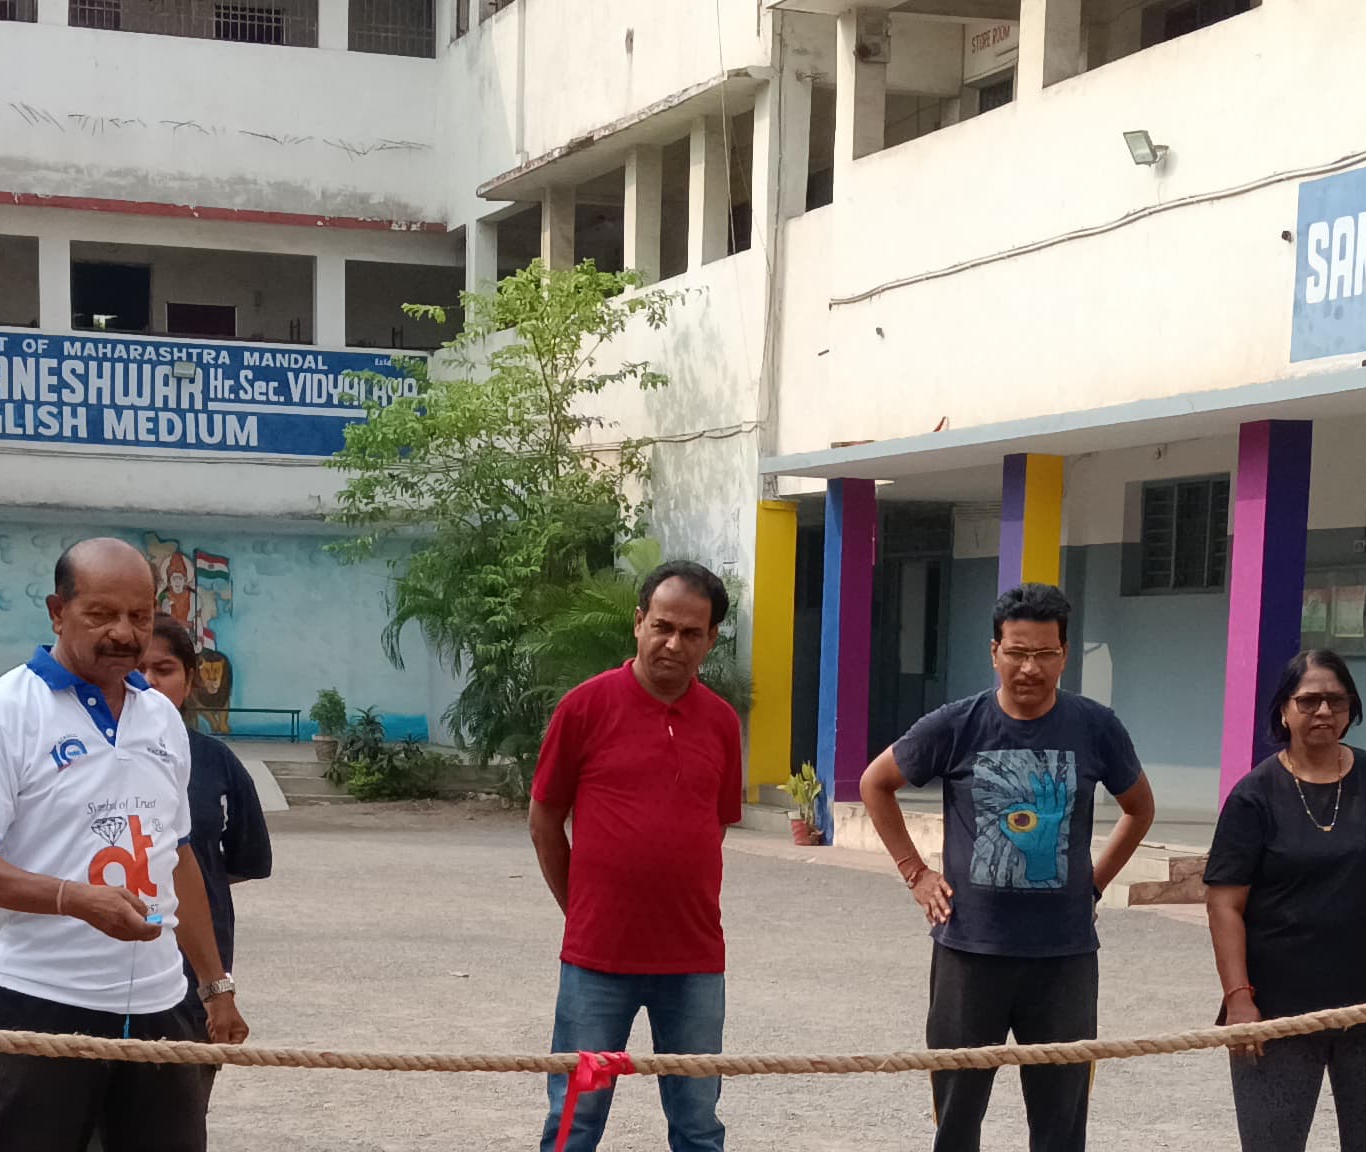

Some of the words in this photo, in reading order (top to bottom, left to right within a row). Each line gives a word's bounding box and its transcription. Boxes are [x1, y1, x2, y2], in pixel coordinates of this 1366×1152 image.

[21, 338, 50, 354] OF
[63, 340, 231, 365] MAHARASHTRA
[243, 351, 329, 370] MANDAL
[239, 369, 285, 402] Sec.
[103, 408, 259, 447] MEDIUM
